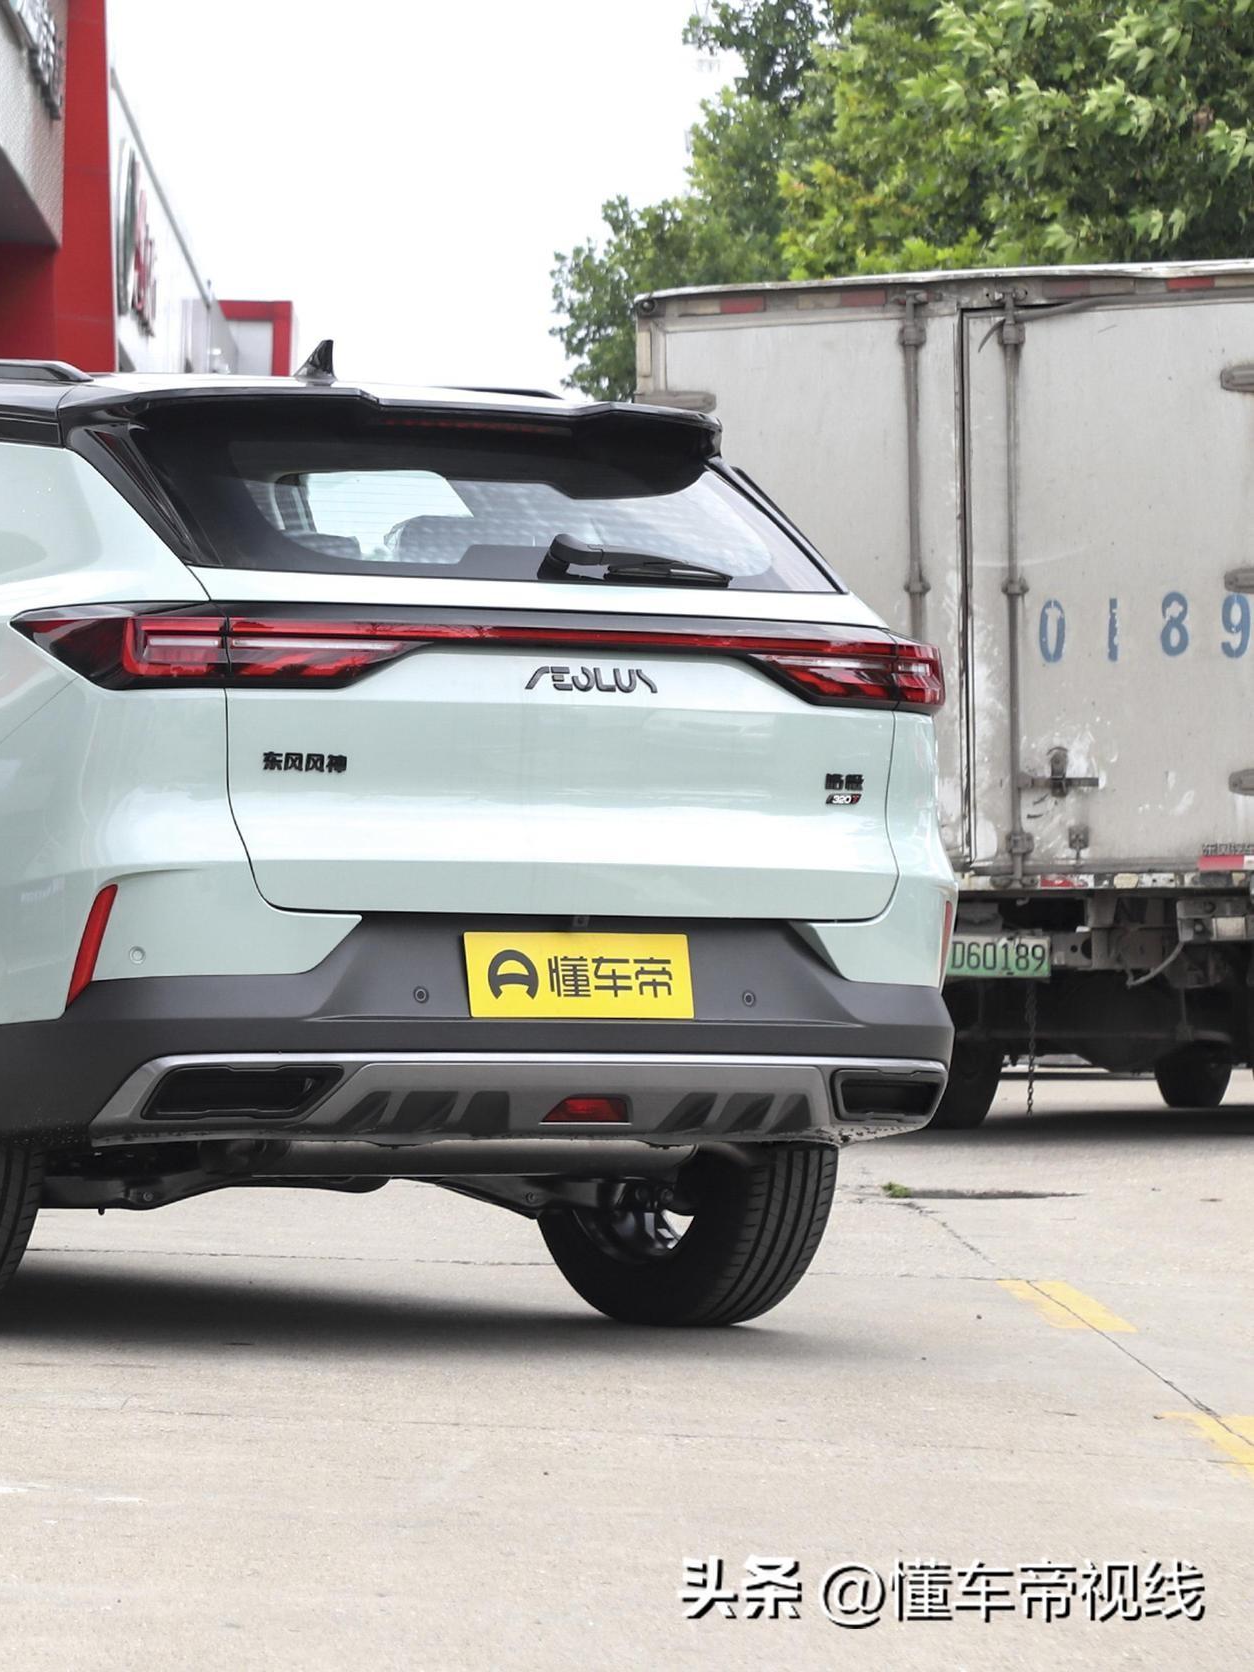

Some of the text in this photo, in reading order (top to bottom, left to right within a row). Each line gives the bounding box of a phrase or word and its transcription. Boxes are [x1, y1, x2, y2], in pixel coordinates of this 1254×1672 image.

[263, 752, 347, 773] 东风风神
[951, 941, 1046, 972] D60189
[548, 956, 673, 998] 懂车帝
